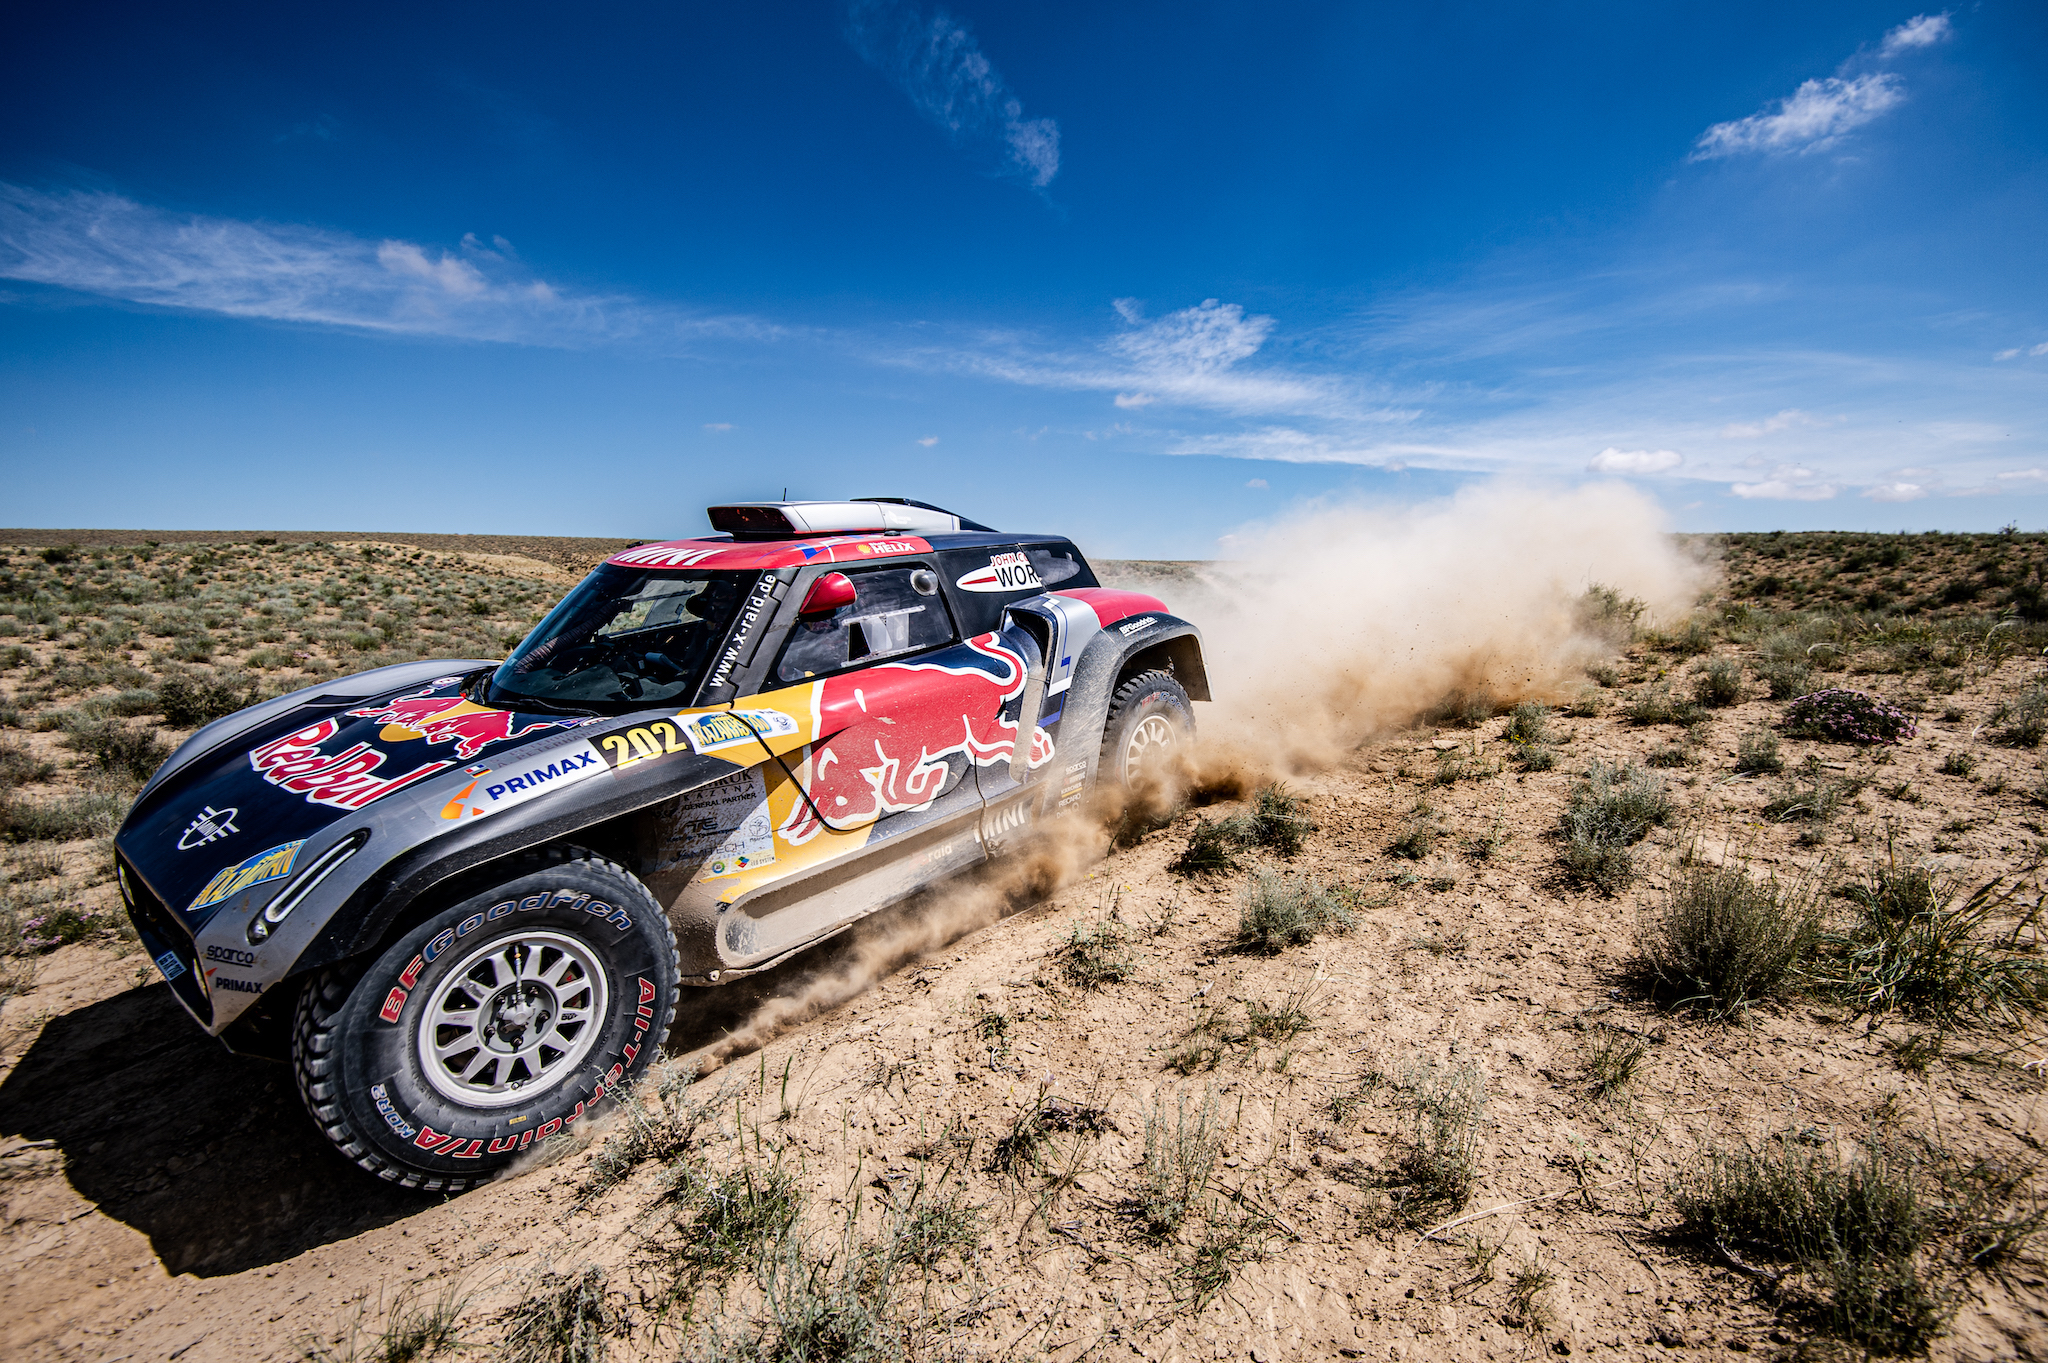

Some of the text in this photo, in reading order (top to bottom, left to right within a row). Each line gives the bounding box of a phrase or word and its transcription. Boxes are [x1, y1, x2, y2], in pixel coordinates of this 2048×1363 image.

[614, 546, 728, 566] MINI
[870, 541, 916, 554] HELIX
[992, 554, 1016, 567] JOHN
[995, 564, 1039, 588] WOR
[709, 574, 777, 688] www.x-raid.de
[602, 722, 688, 770] 202
[249, 717, 457, 810] Red Bull
[486, 751, 597, 800] PRIMAX
[684, 783, 754, 801] KAZYNA
[684, 792, 757, 810] GENERAL PARTNER
[1058, 793, 1081, 807] RECARO
[973, 802, 1025, 844] MINI
[207, 945, 254, 965] sparco
[379, 891, 634, 1025] BFGoodrich
[216, 977, 263, 993] PRIMAX
